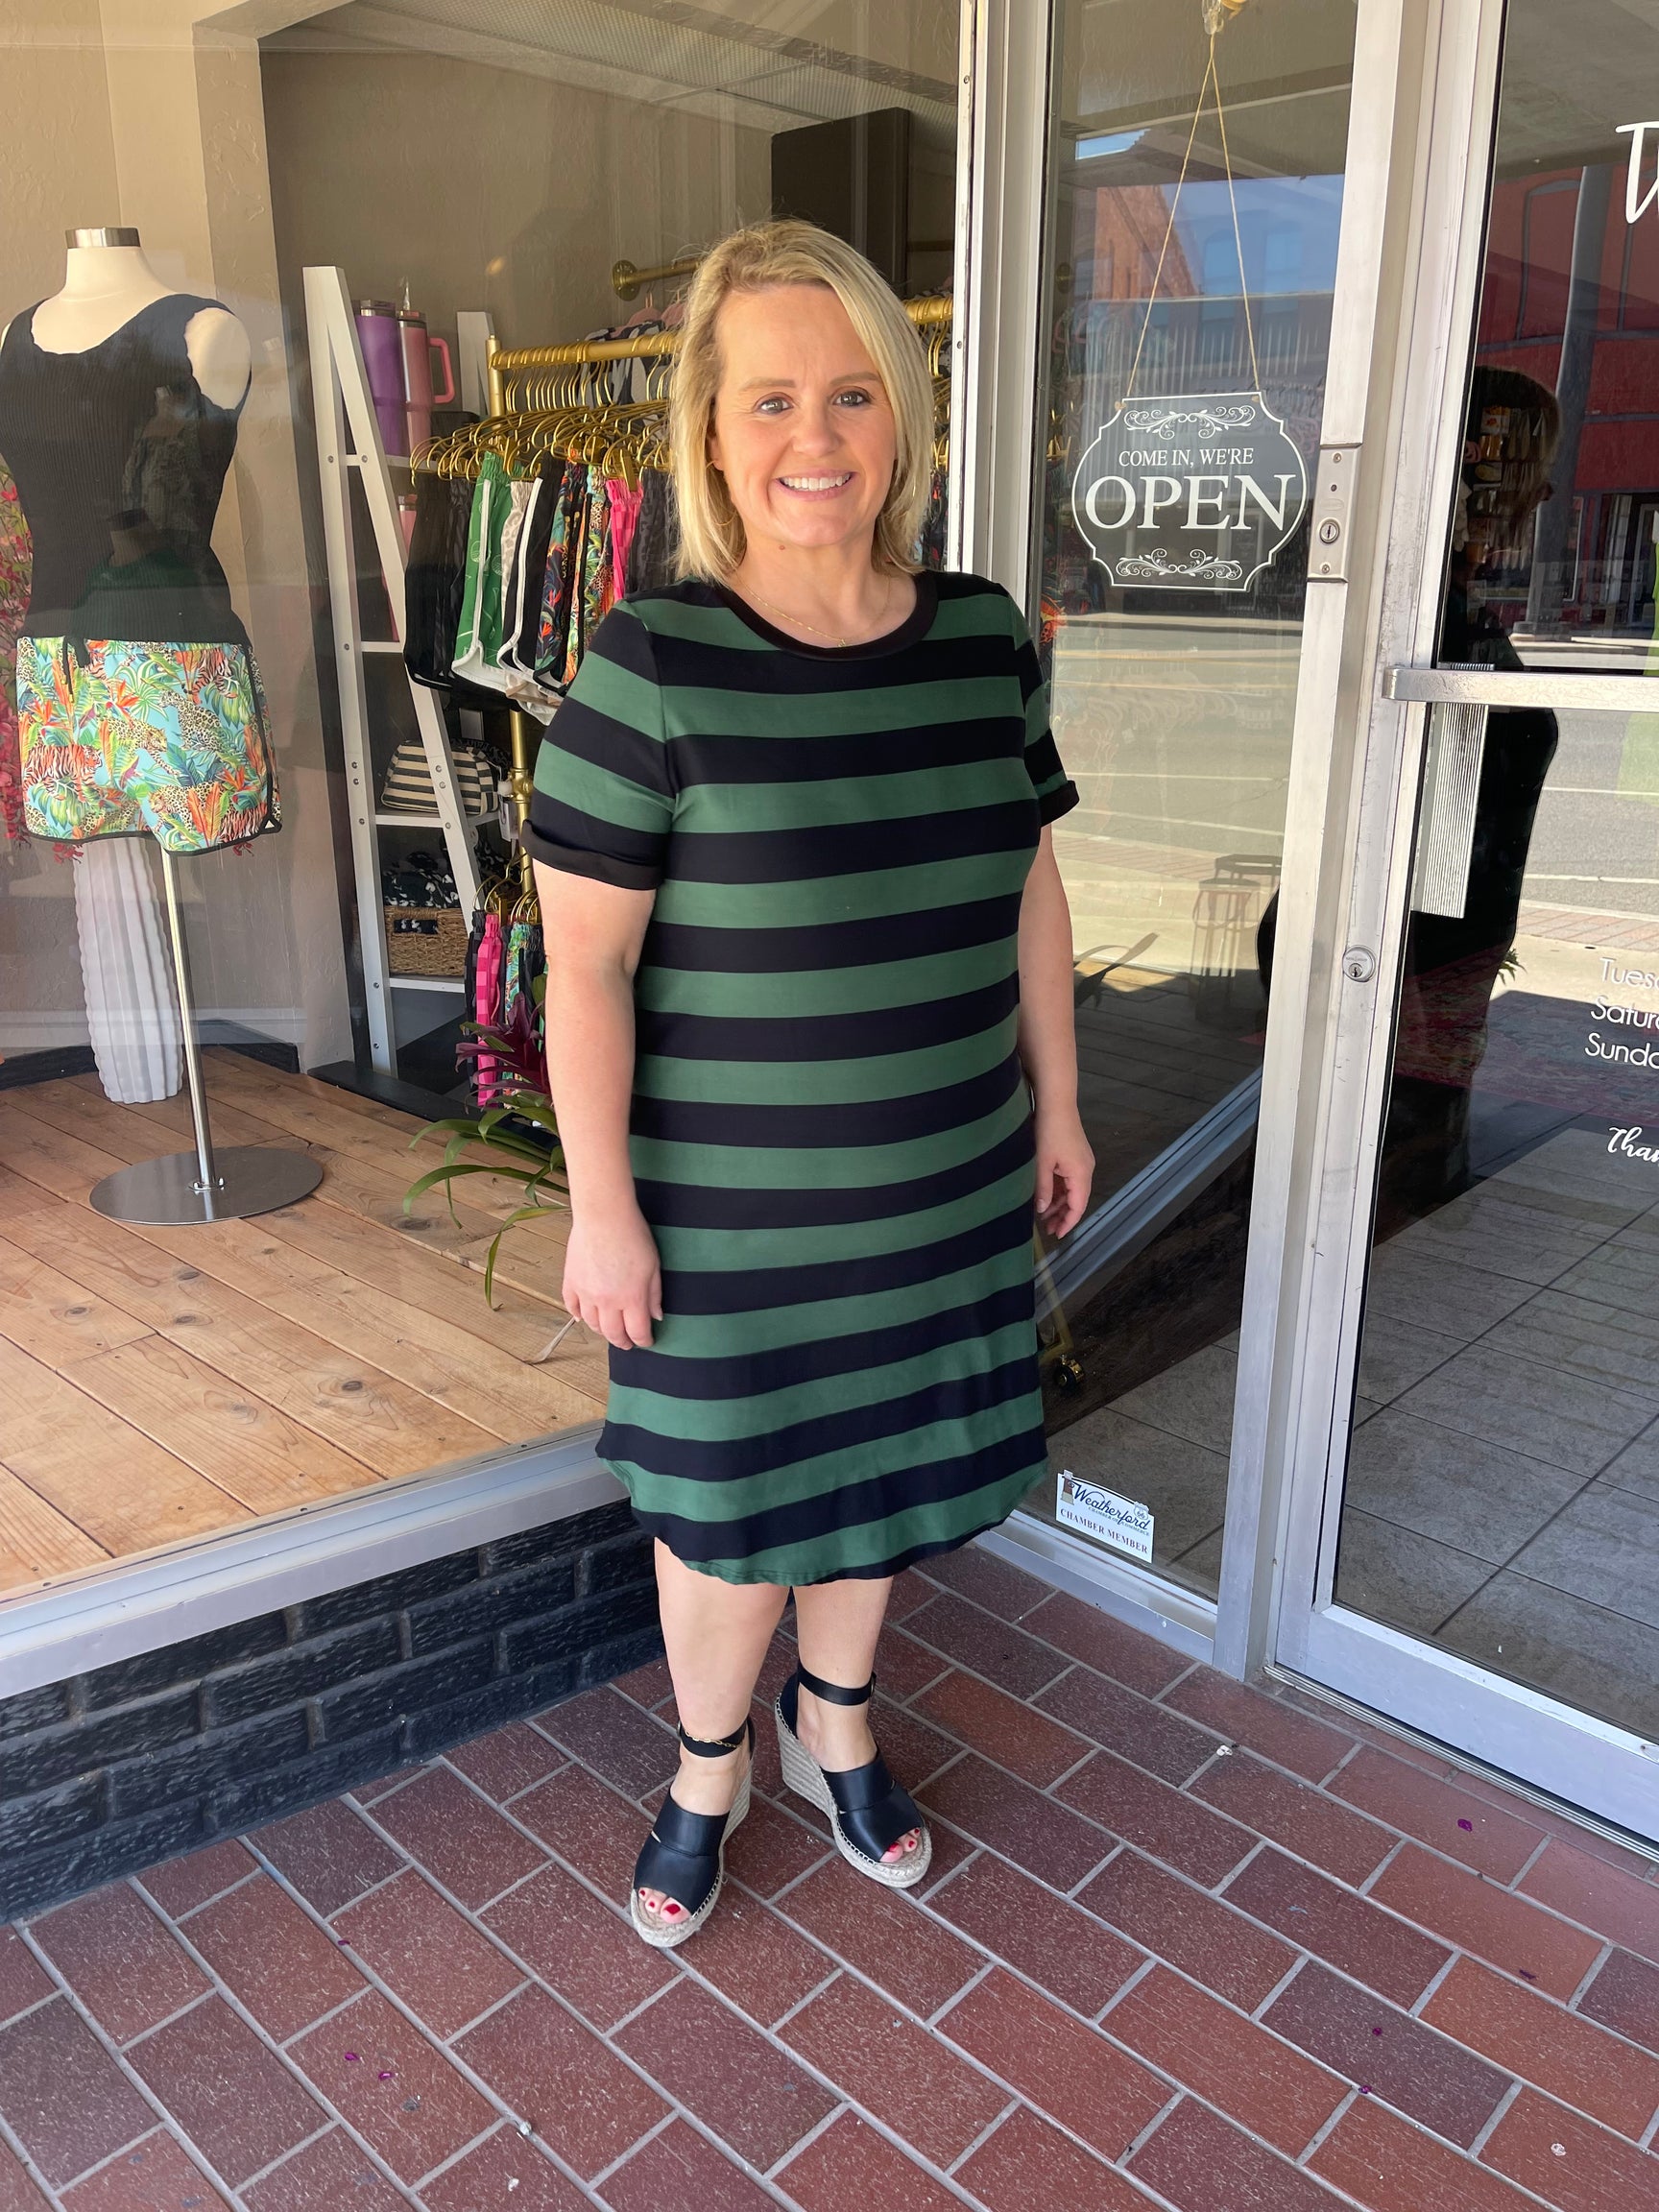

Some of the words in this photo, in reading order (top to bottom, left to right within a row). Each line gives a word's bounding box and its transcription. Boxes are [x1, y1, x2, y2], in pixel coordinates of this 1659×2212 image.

[1118, 449, 1168, 468] COME
[1171, 448, 1194, 468] IN,
[1199, 446, 1254, 466] WE'RE
[1085, 473, 1296, 531] OPEN
[1590, 996, 1659, 1030] Satur
[1069, 1479, 1151, 1530] Weatherford
[1060, 1508, 1105, 1535] CHAMBER
[1107, 1528, 1148, 1554] MEMBER
